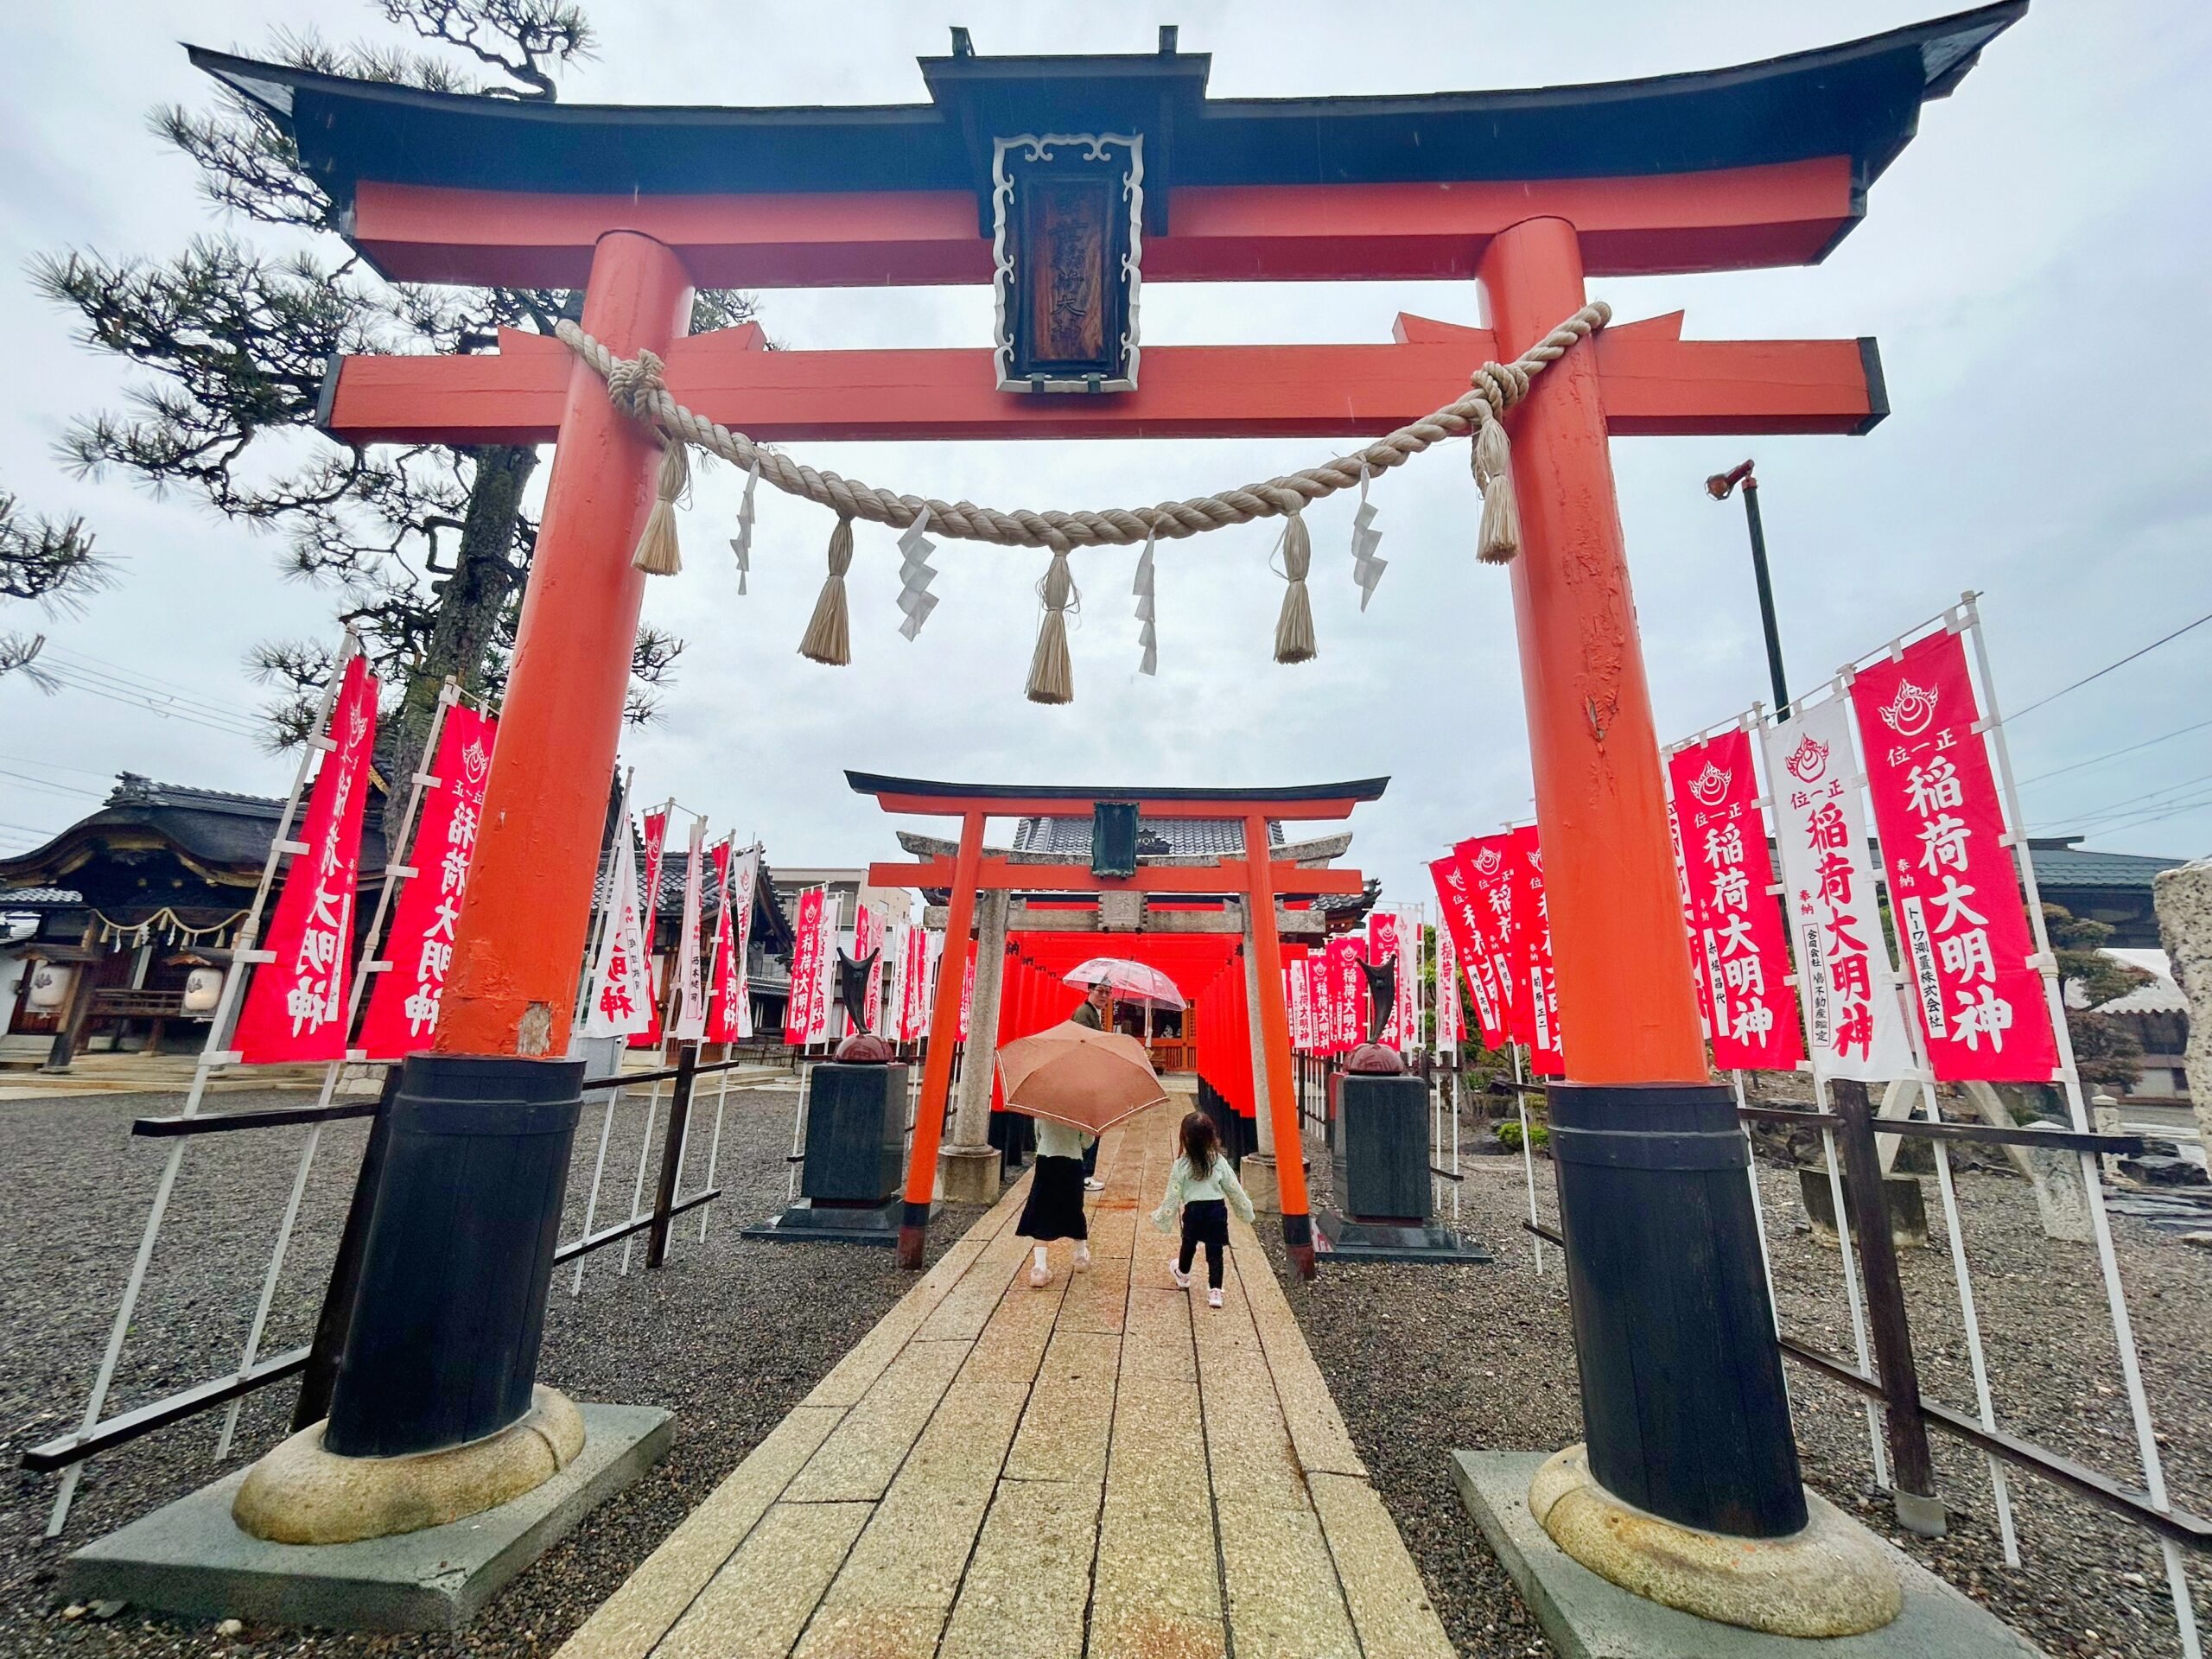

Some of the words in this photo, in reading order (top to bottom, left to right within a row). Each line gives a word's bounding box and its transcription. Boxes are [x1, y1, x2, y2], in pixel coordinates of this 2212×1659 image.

[1700, 899, 1710, 922] 奉納
[1799, 889, 1815, 916] 奉納
[1897, 858, 1915, 887] 奉納
[1905, 755, 2013, 1054] 稲荷大明神
[1529, 943, 1539, 962] 奉納
[1703, 822, 1774, 1049] 稲荷大明神
[1805, 802, 1873, 1062] 稲荷大明神
[1908, 907, 1943, 1027] トーワ測量株式会社
[795, 932, 814, 1034] 稲荷大明神
[1342, 968, 1357, 1045] 稲荷大明神
[1533, 976, 1548, 1028] 前原正二
